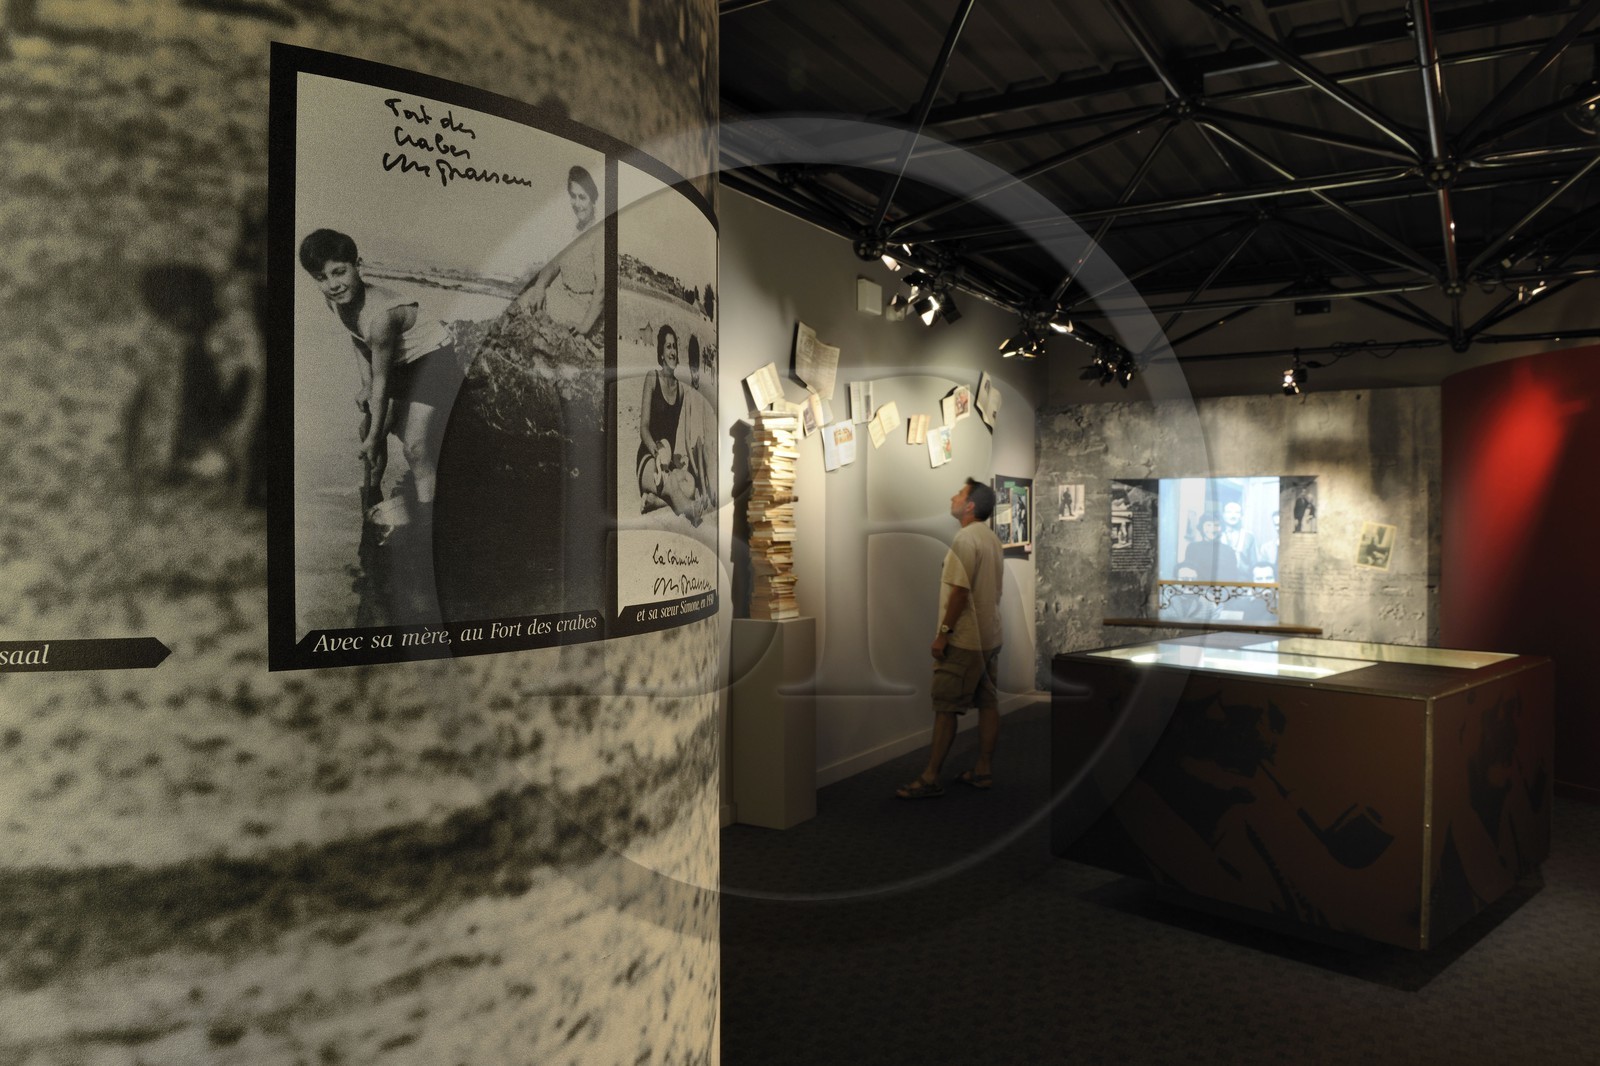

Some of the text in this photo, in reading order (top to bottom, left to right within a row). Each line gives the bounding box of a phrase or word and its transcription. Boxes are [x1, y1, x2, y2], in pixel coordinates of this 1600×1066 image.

[636, 608, 646, 622] et
[647, 608, 659, 621] sa
[312, 613, 598, 653] Avec sa mère, au Fort des crabes
